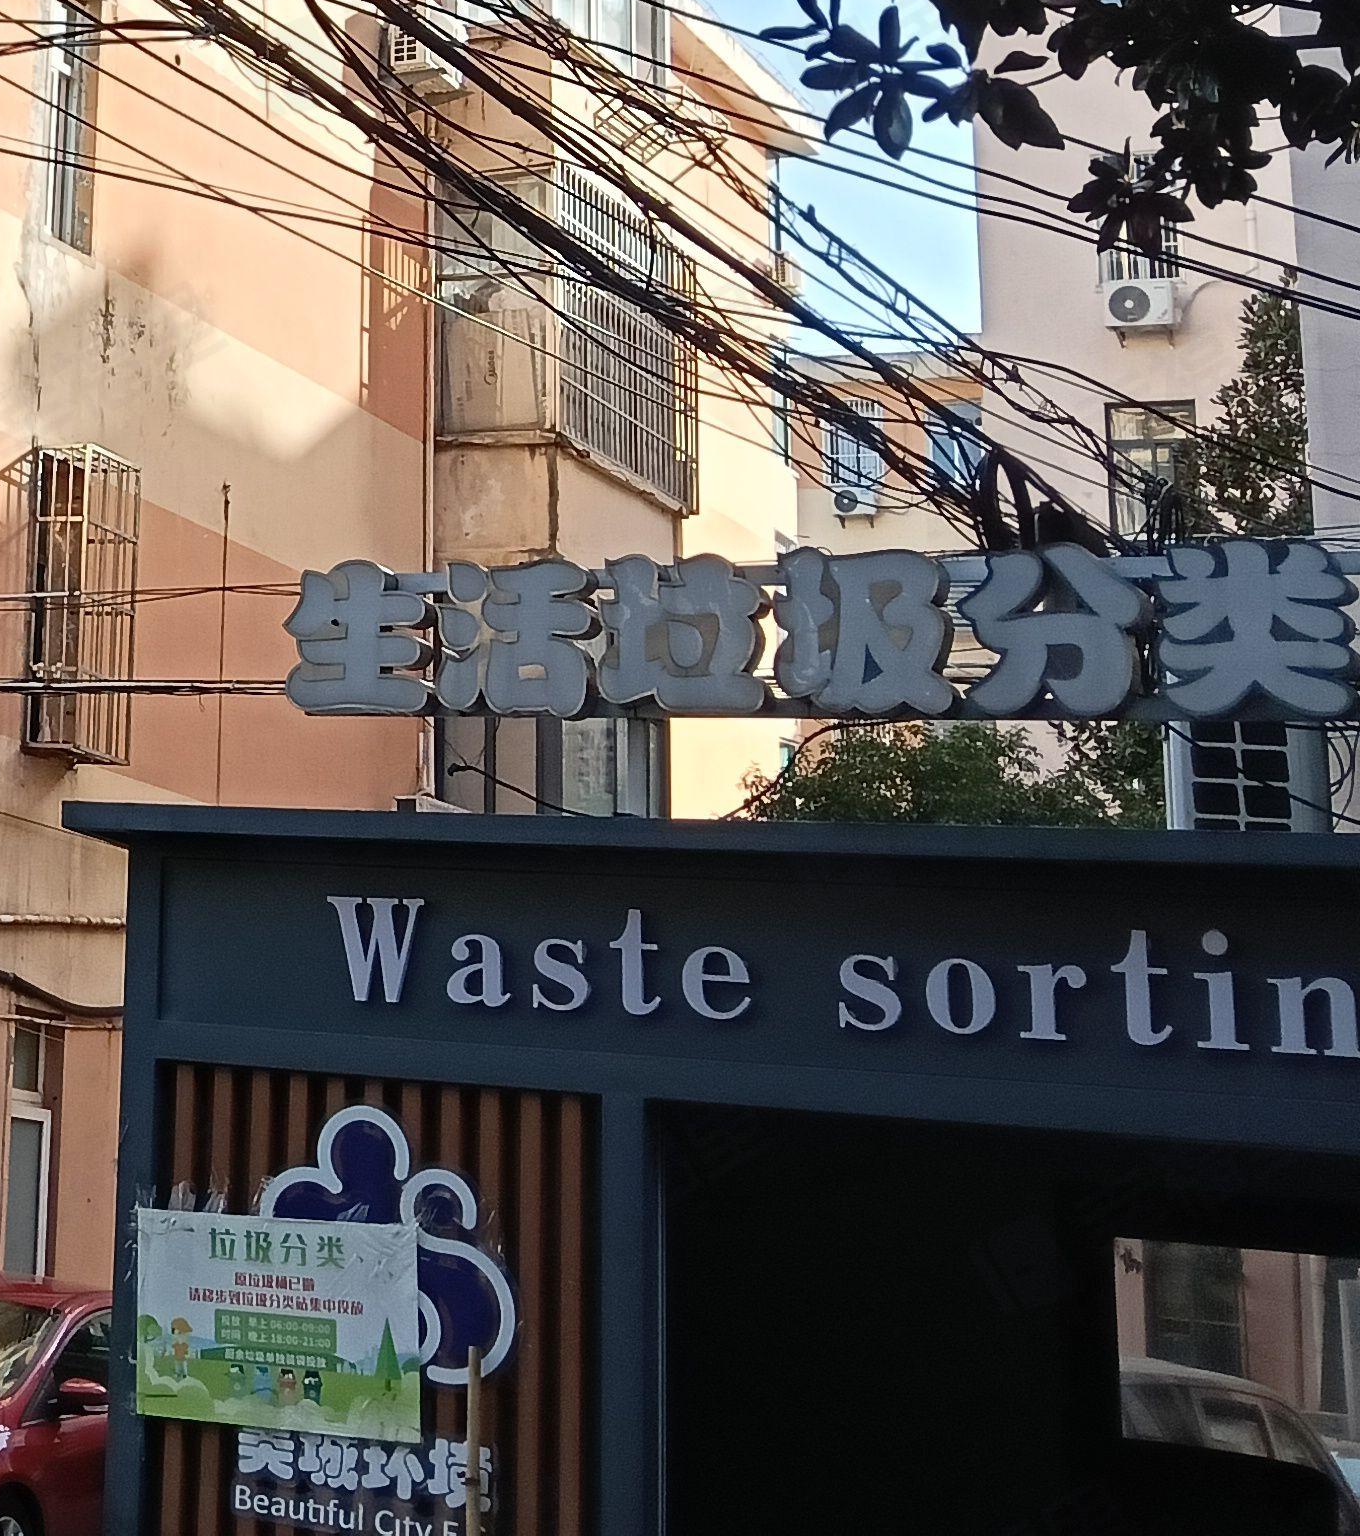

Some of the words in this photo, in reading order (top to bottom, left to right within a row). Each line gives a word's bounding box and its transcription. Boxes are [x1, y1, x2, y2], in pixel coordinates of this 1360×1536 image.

[283, 540, 1359, 720] 生活垃圾分类
[327, 896, 753, 1021] Waste
[837, 929, 1360, 1058] sortin
[209, 1227, 345, 1270] 垃圾分类
[234, 1483, 364, 1532] Beautiful
